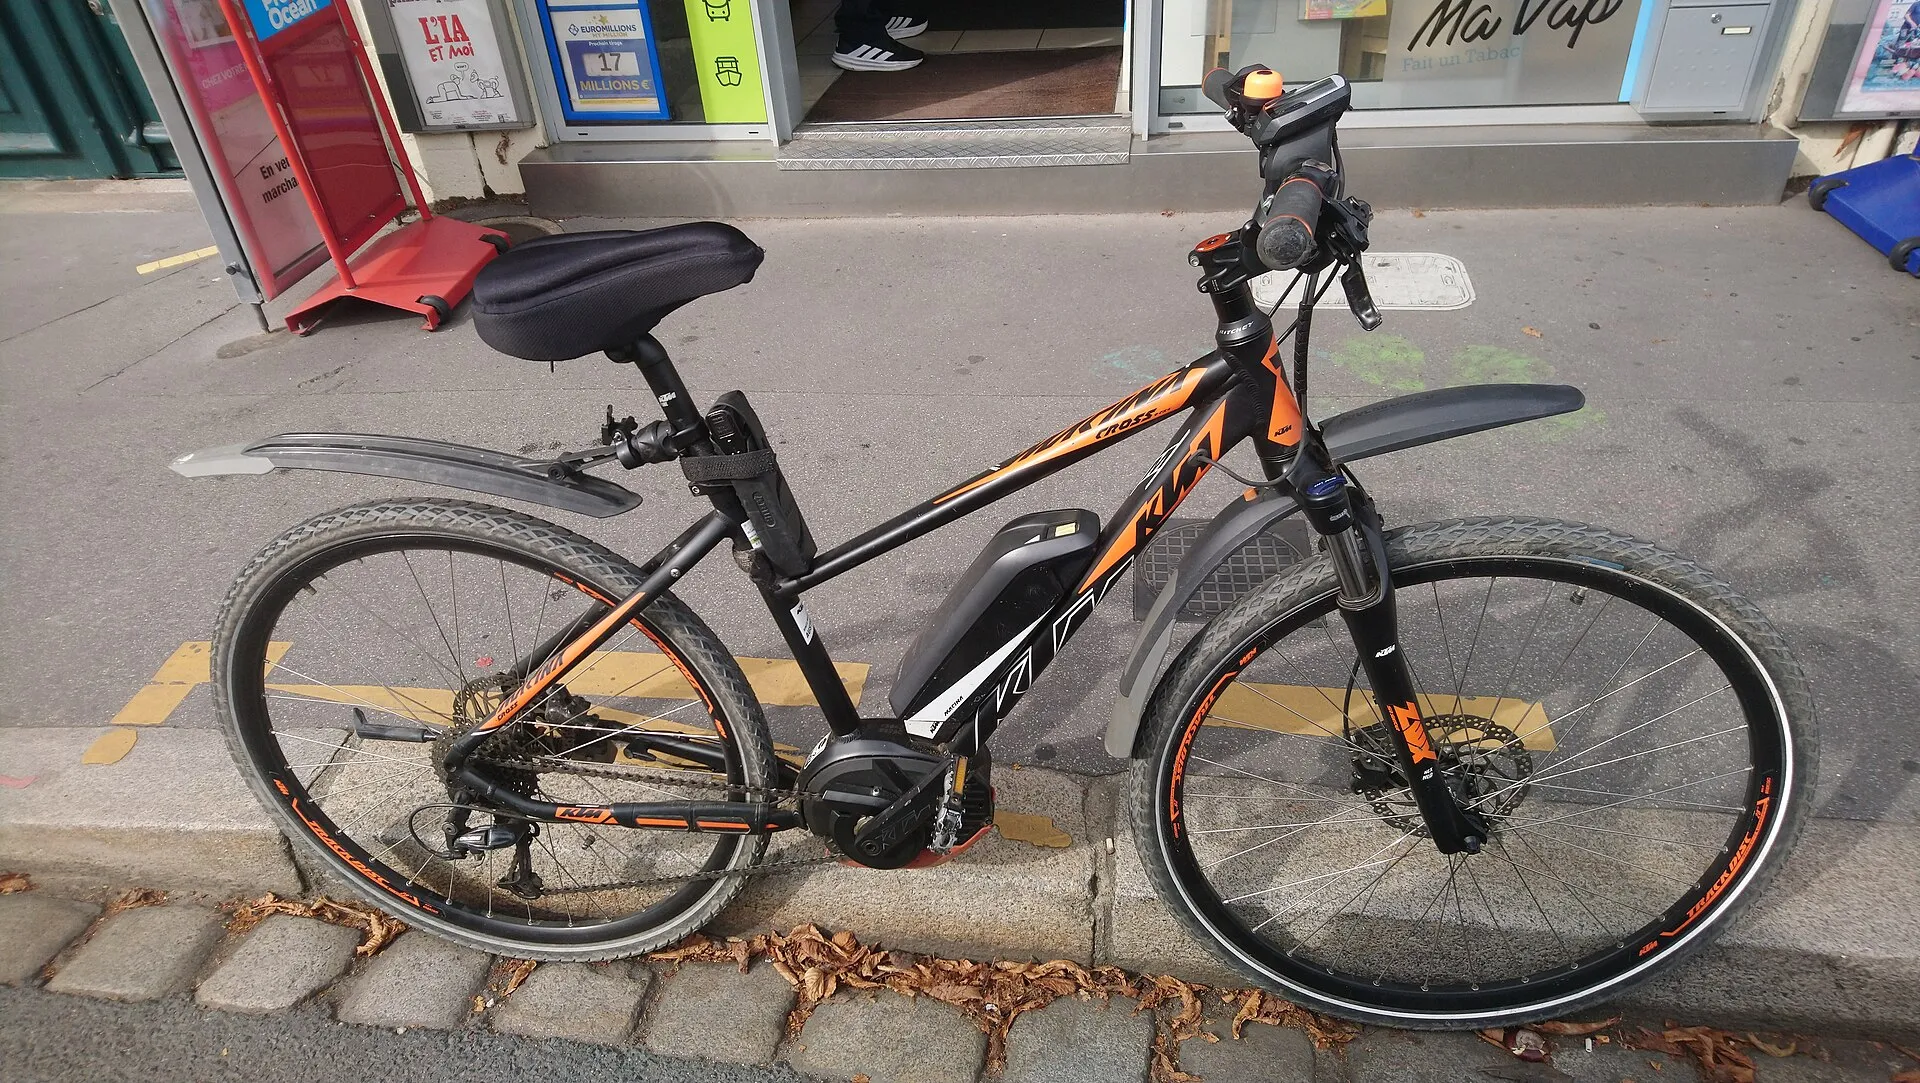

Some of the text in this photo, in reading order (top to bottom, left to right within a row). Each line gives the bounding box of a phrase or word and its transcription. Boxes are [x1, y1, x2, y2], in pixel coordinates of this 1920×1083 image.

[580, 24, 637, 33] EUROMILLIONS
[1407, 0, 1501, 52] Ma
[428, 45, 444, 62] ET
[598, 52, 621, 72] 17
[1402, 45, 1521, 72] Fait un Tabac
[580, 79, 650, 92] MILLIONS €
[260, 165, 275, 180] En
[1095, 408, 1158, 440] CROSS
[1274, 424, 1292, 437] KTM
[559, 808, 602, 819] KTM
[1686, 831, 1752, 920] TRACK DISC
